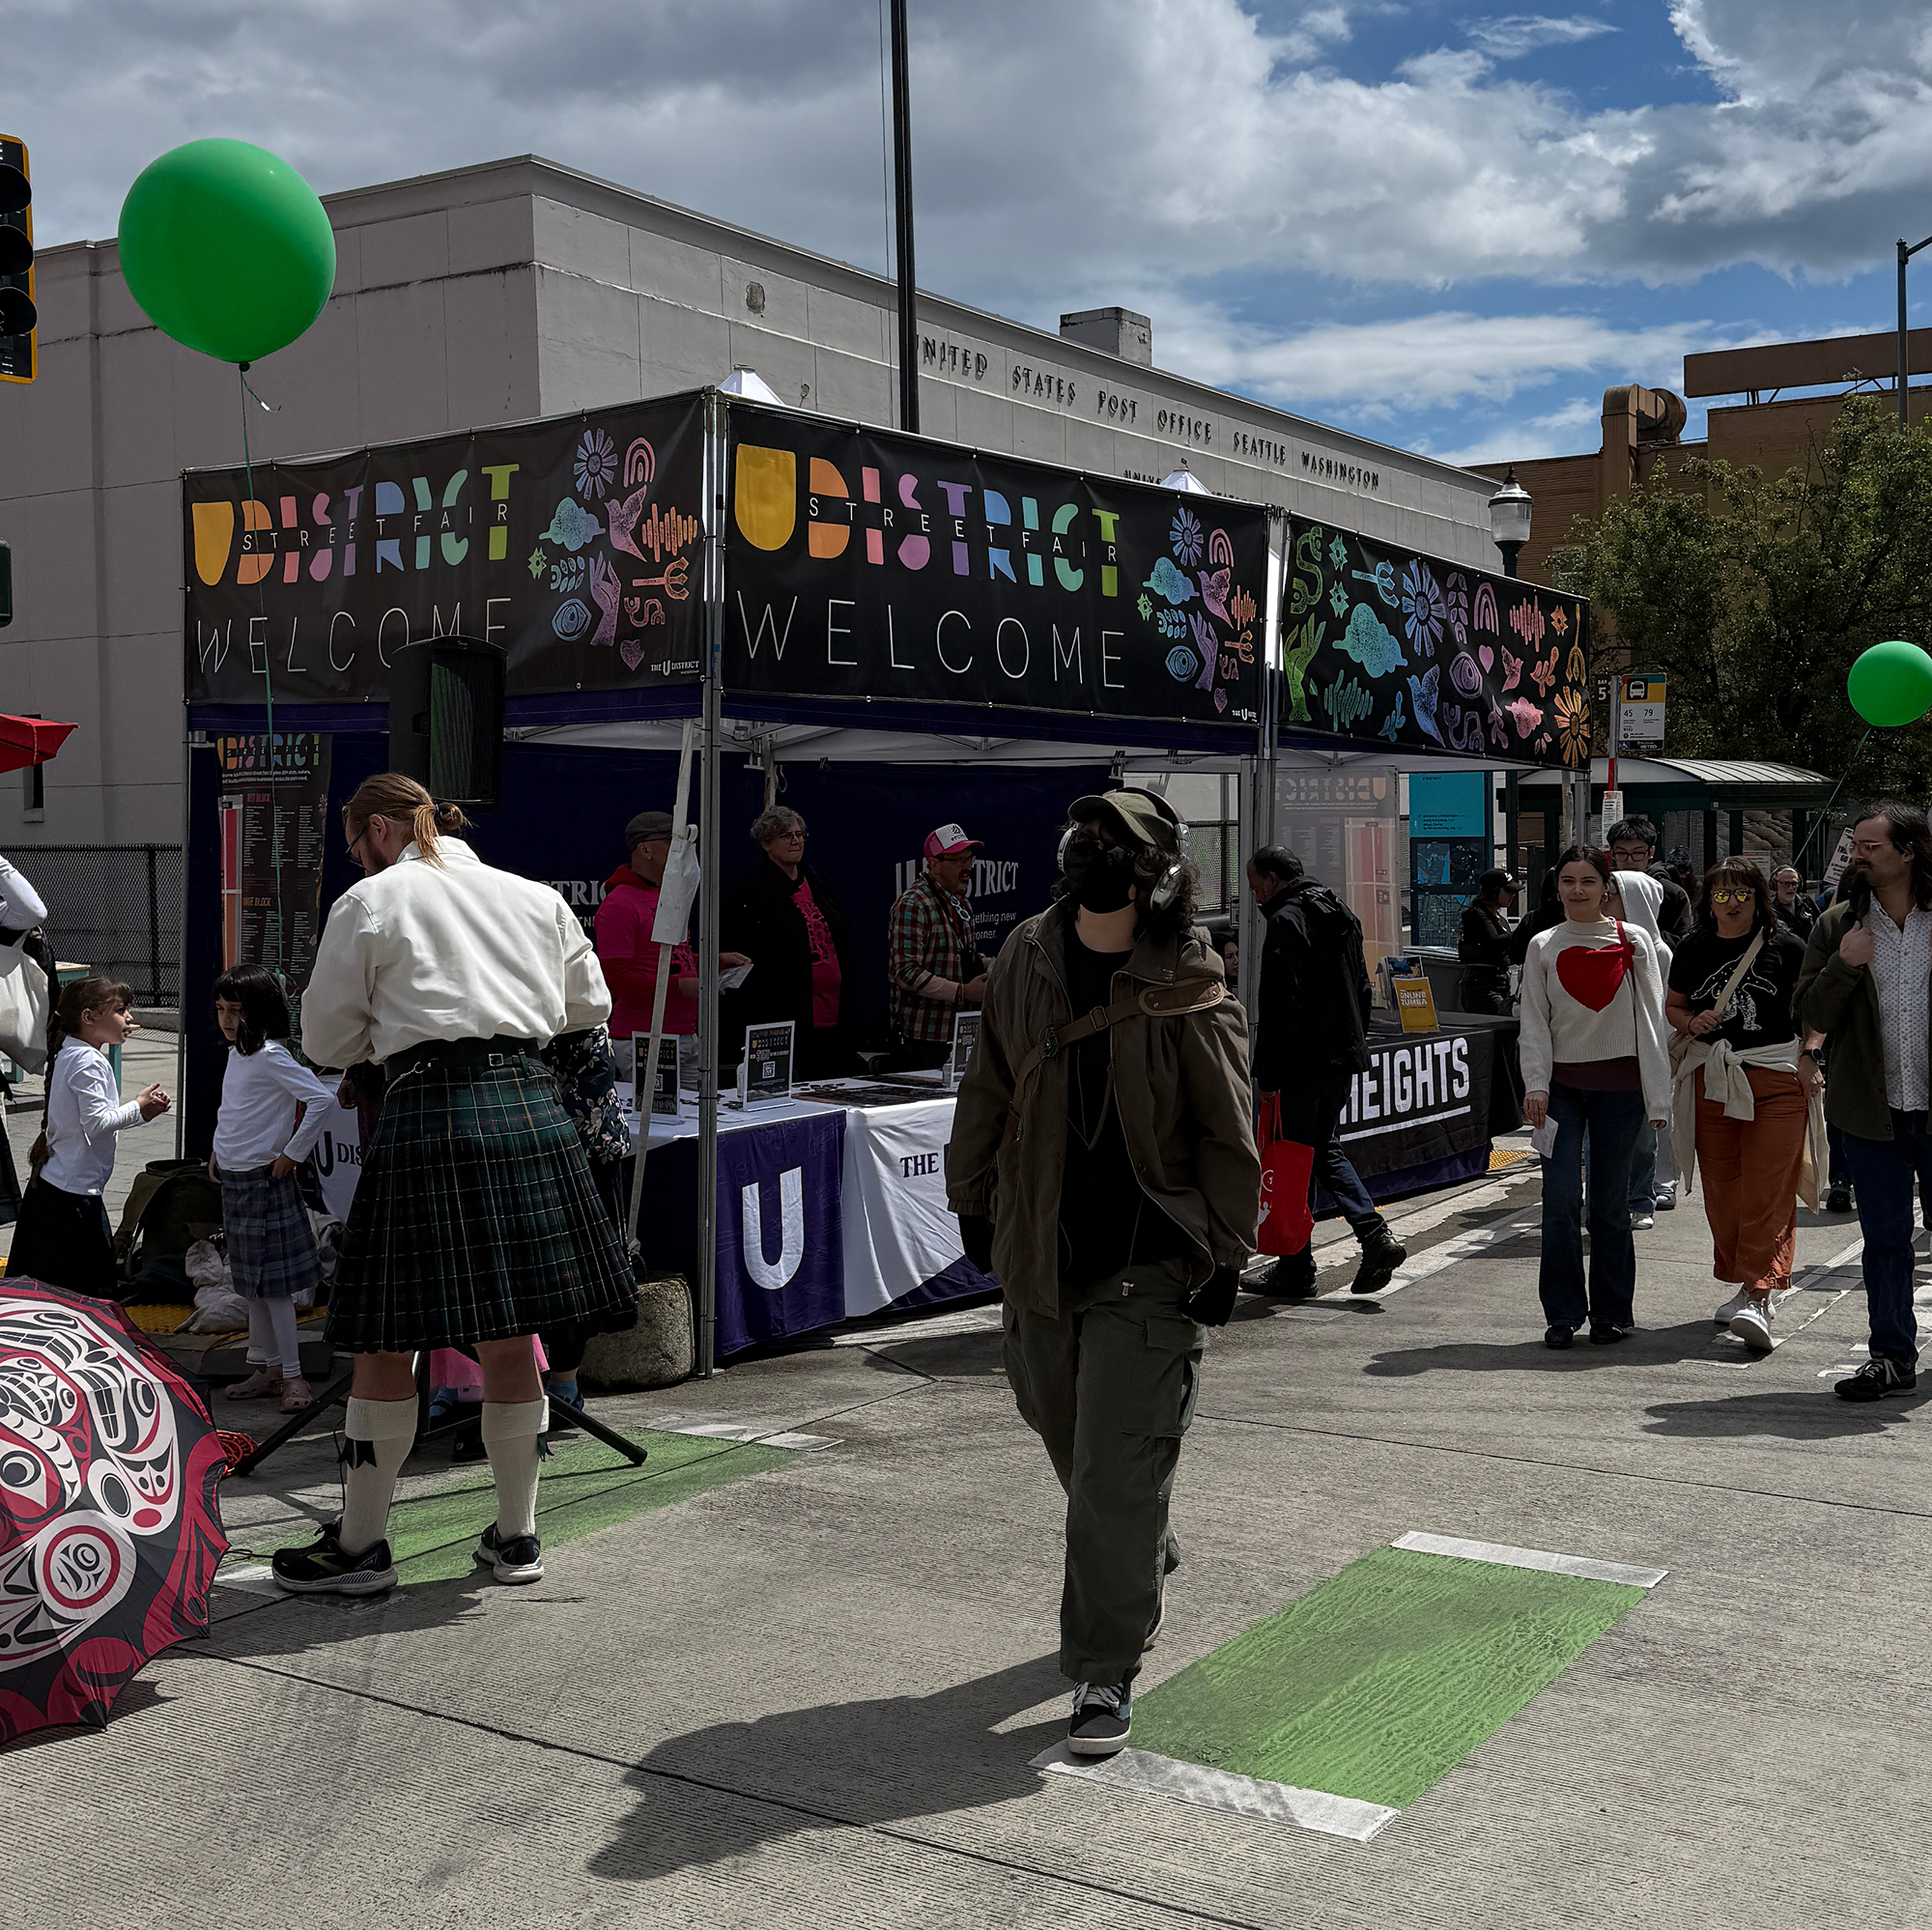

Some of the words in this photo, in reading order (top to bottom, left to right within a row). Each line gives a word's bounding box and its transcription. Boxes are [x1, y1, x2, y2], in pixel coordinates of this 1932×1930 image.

[917, 335, 987, 376] NITED
[1013, 365, 1076, 400] STATES
[1098, 389, 1138, 419] POST
[1158, 409, 1211, 440] OFFICE
[1233, 431, 1287, 462] SEATTLE
[1301, 451, 1380, 488] WASHINGTON
[237, 464, 520, 585] DISTRICT
[242, 519, 385, 551] STREET
[413, 503, 508, 532] FAIR
[809, 456, 1120, 597] DISTRICT
[809, 497, 994, 543] STREET
[1021, 530, 1117, 562] FAIR
[196, 597, 512, 674] WELCOME
[737, 589, 1125, 689] WELCOME
[663, 660, 670, 676] U
[1598, 687, 1606, 700] 5
[1644, 708, 1653, 717] 79
[226, 733, 322, 770] DISTRICT
[1001, 912, 1017, 922] new
[315, 1130, 334, 1178] U
[899, 1152, 940, 1178] THE
[742, 1166, 805, 1291] U
